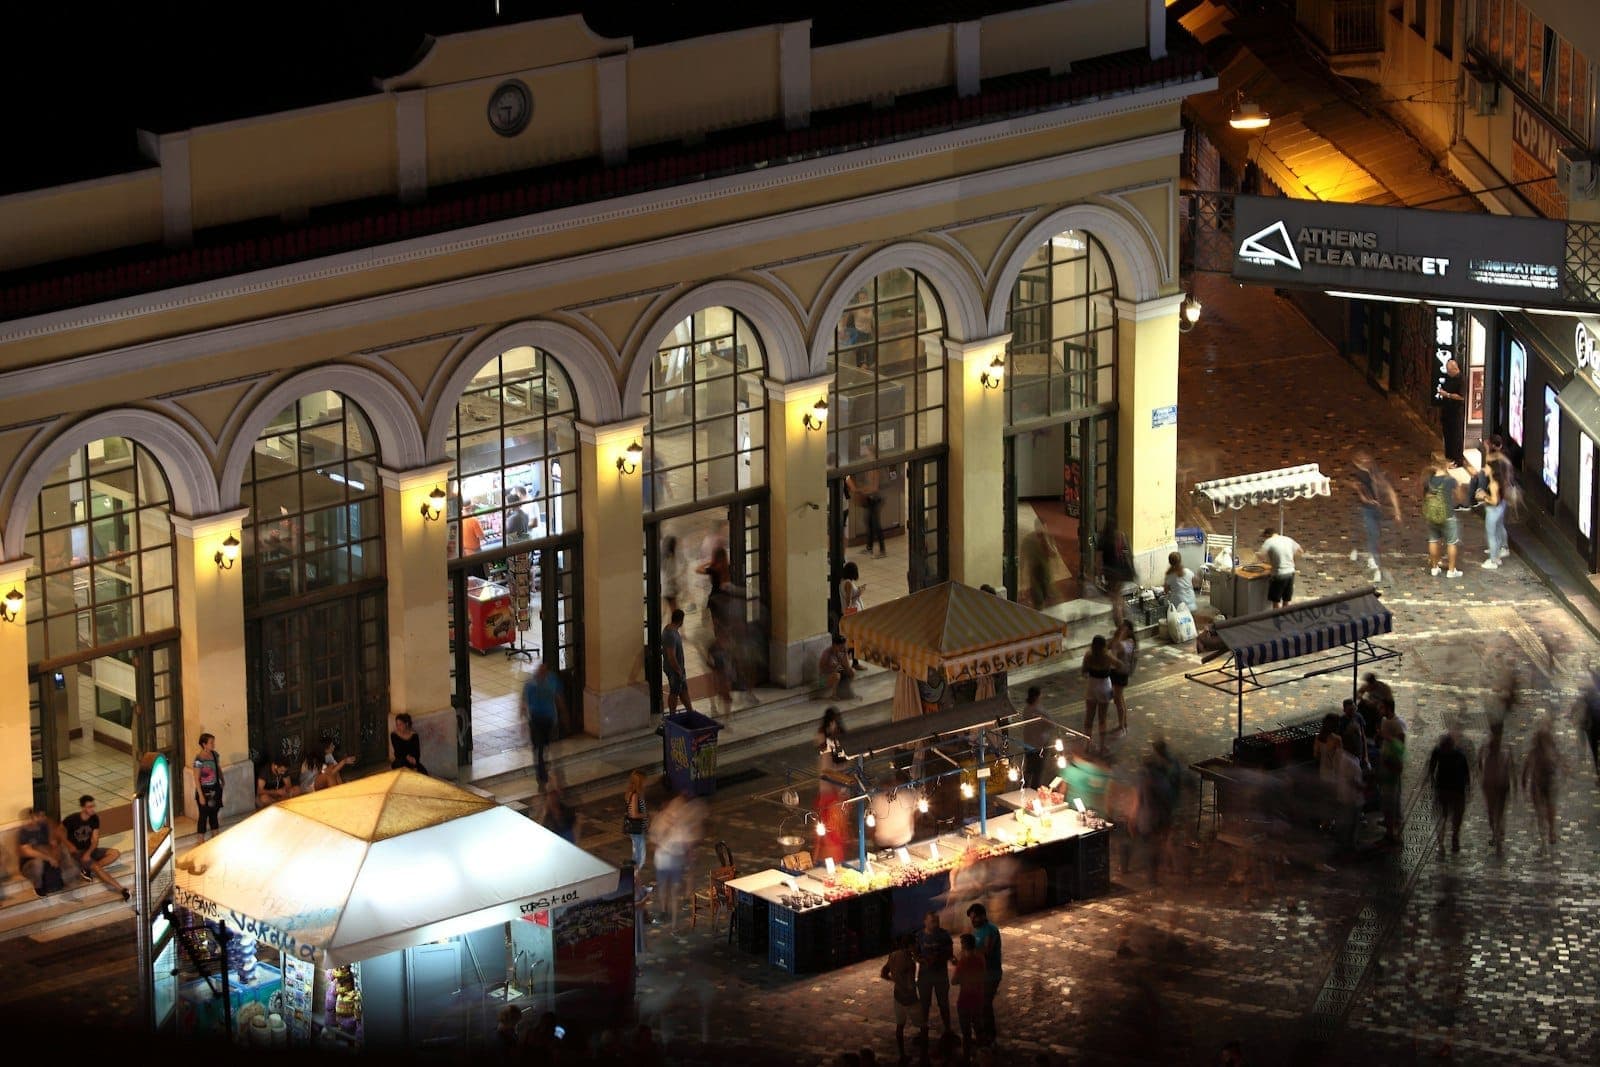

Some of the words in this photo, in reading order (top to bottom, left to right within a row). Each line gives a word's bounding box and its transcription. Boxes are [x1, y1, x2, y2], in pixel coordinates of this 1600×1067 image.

[1297, 227, 1377, 249] ATHENS
[1303, 247, 1356, 267] FLEA
[1361, 251, 1450, 276] MARKET
